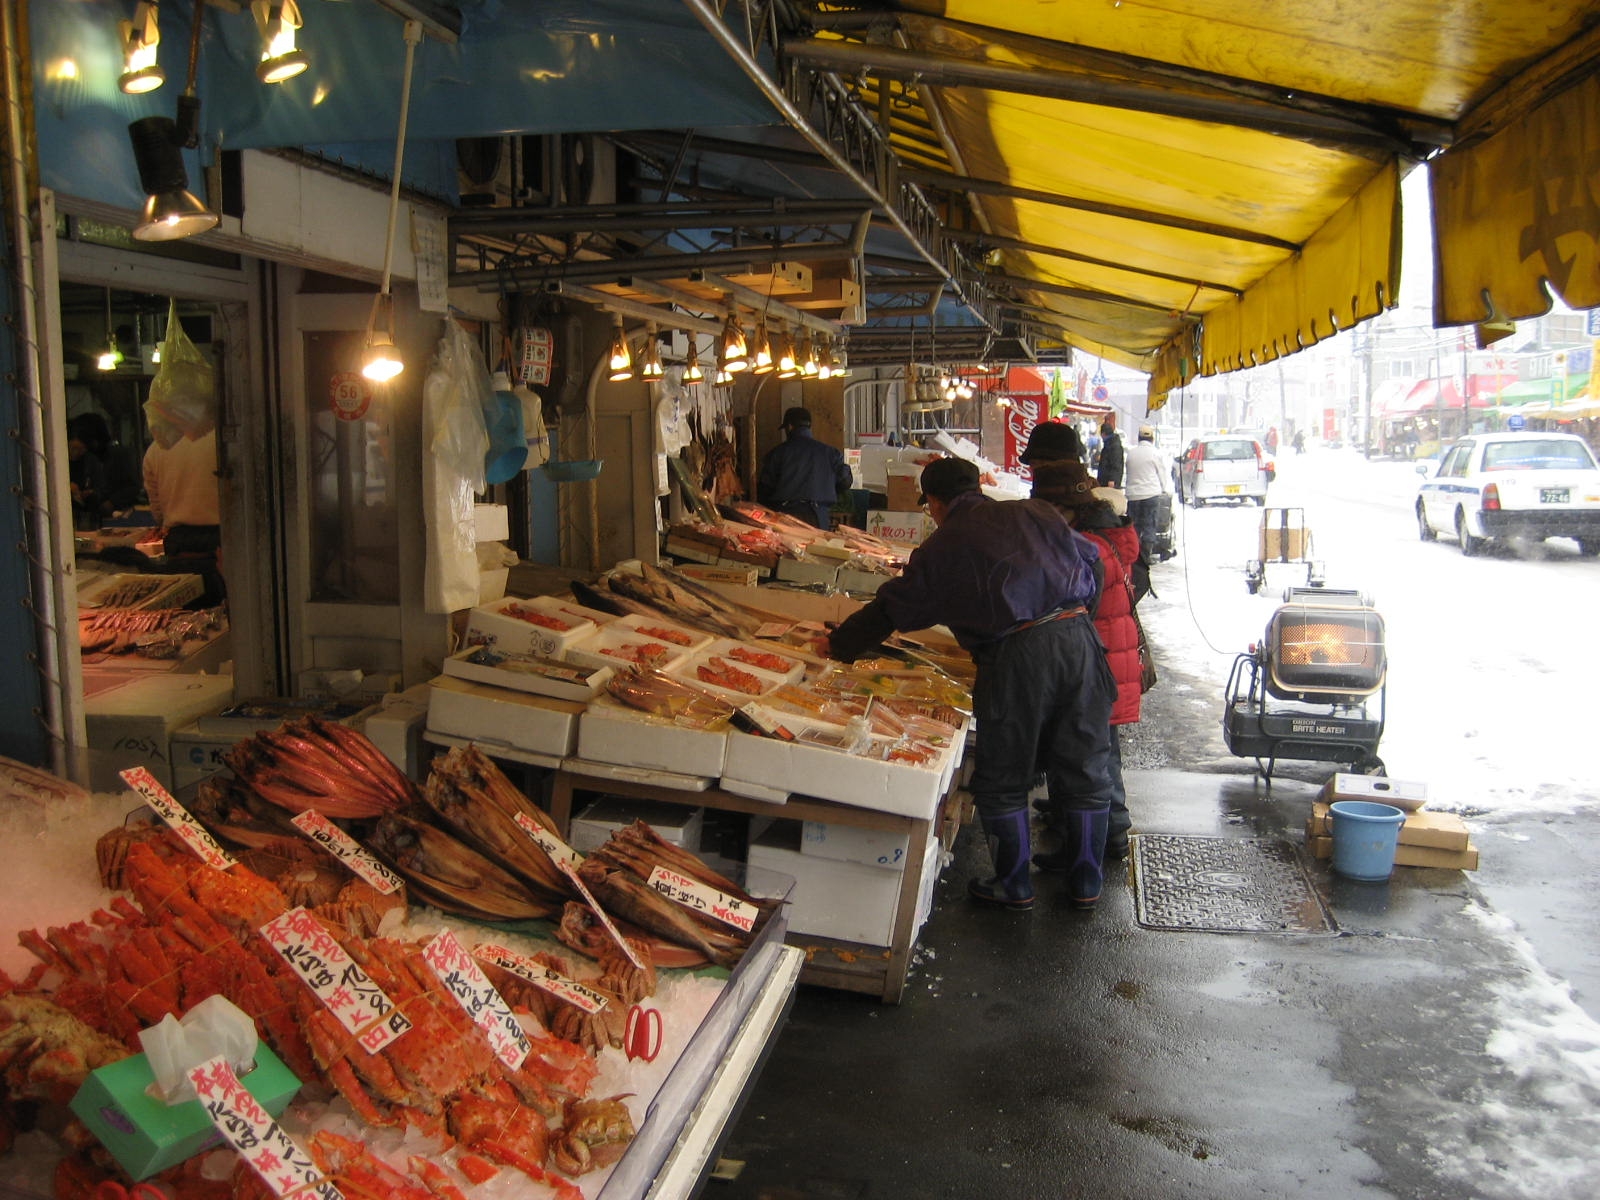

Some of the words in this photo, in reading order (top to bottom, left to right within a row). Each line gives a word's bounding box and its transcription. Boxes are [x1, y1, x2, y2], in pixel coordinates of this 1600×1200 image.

[340, 385, 357, 399] 56
[881, 525, 918, 540] 数の子
[1292, 725, 1315, 734] BRITE
[1316, 726, 1346, 735] HEATER
